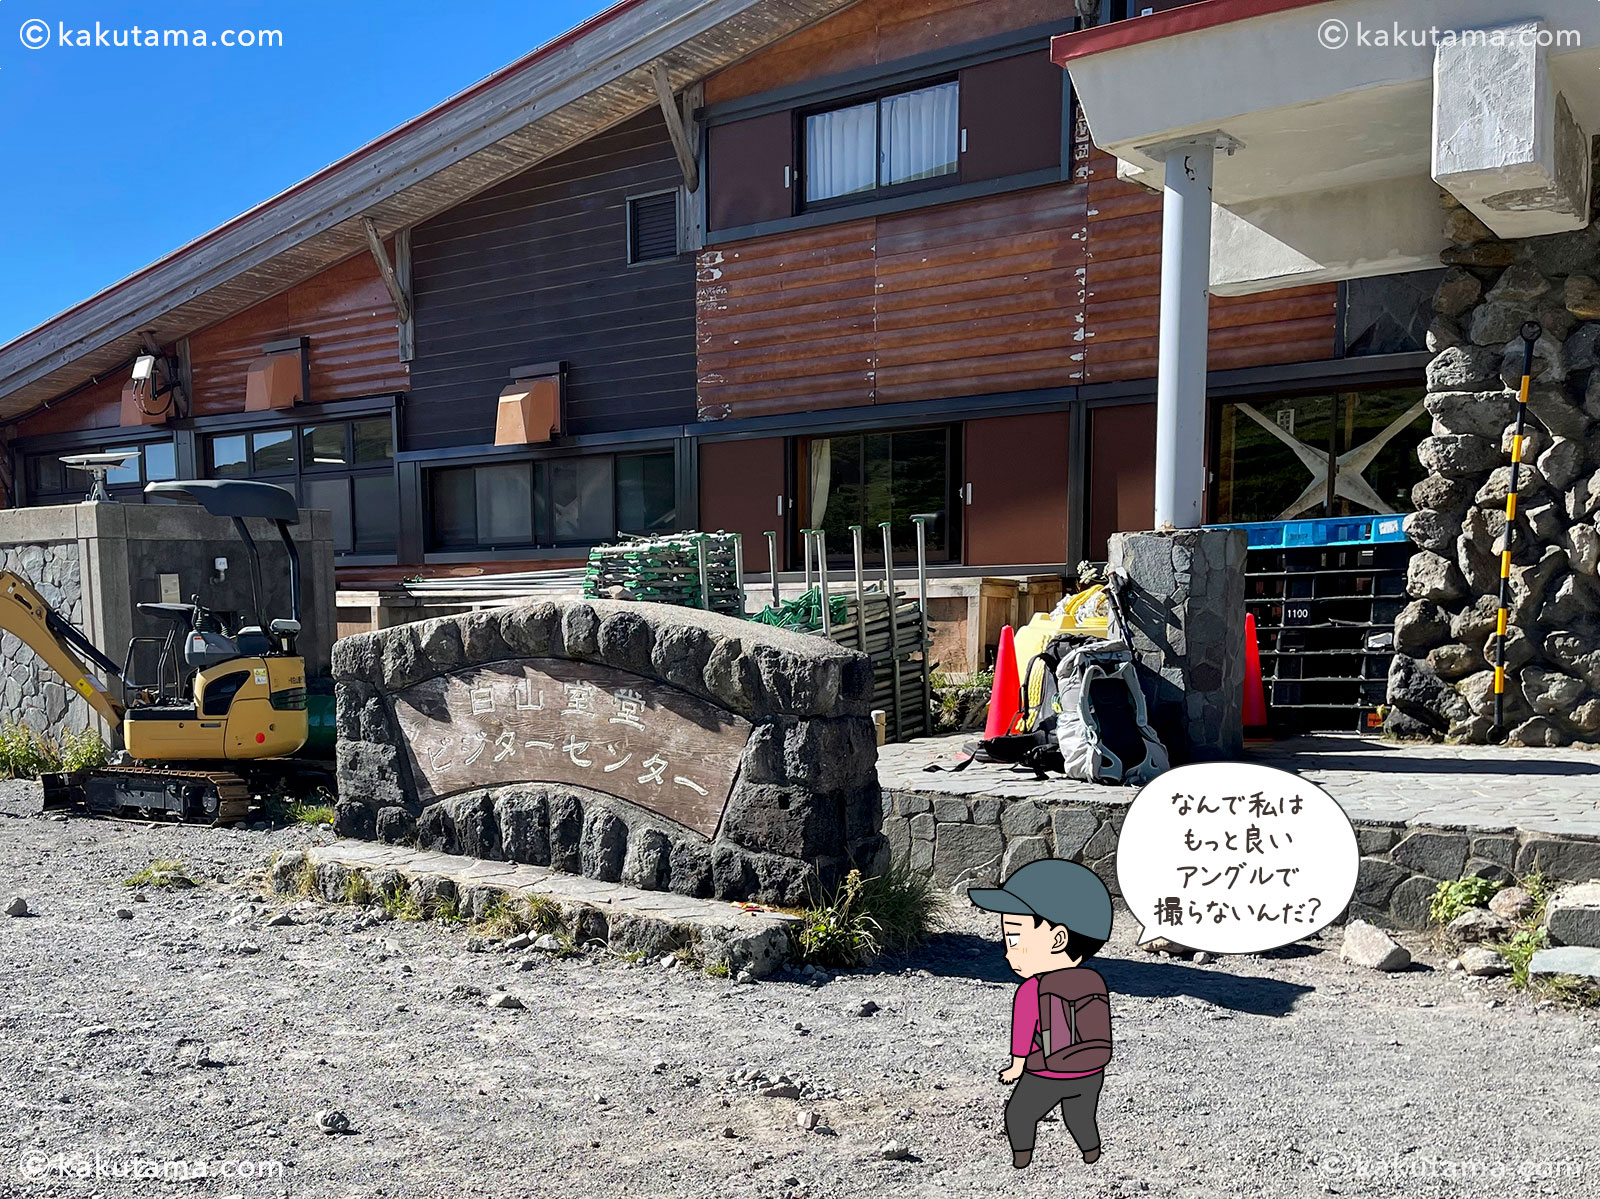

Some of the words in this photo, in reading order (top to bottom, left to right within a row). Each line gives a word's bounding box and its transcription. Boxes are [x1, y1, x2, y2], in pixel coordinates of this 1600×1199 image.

[1287, 608, 1309, 619] 1100
[469, 679, 647, 732] 白山室堂
[427, 730, 709, 797] ビジターセンター
